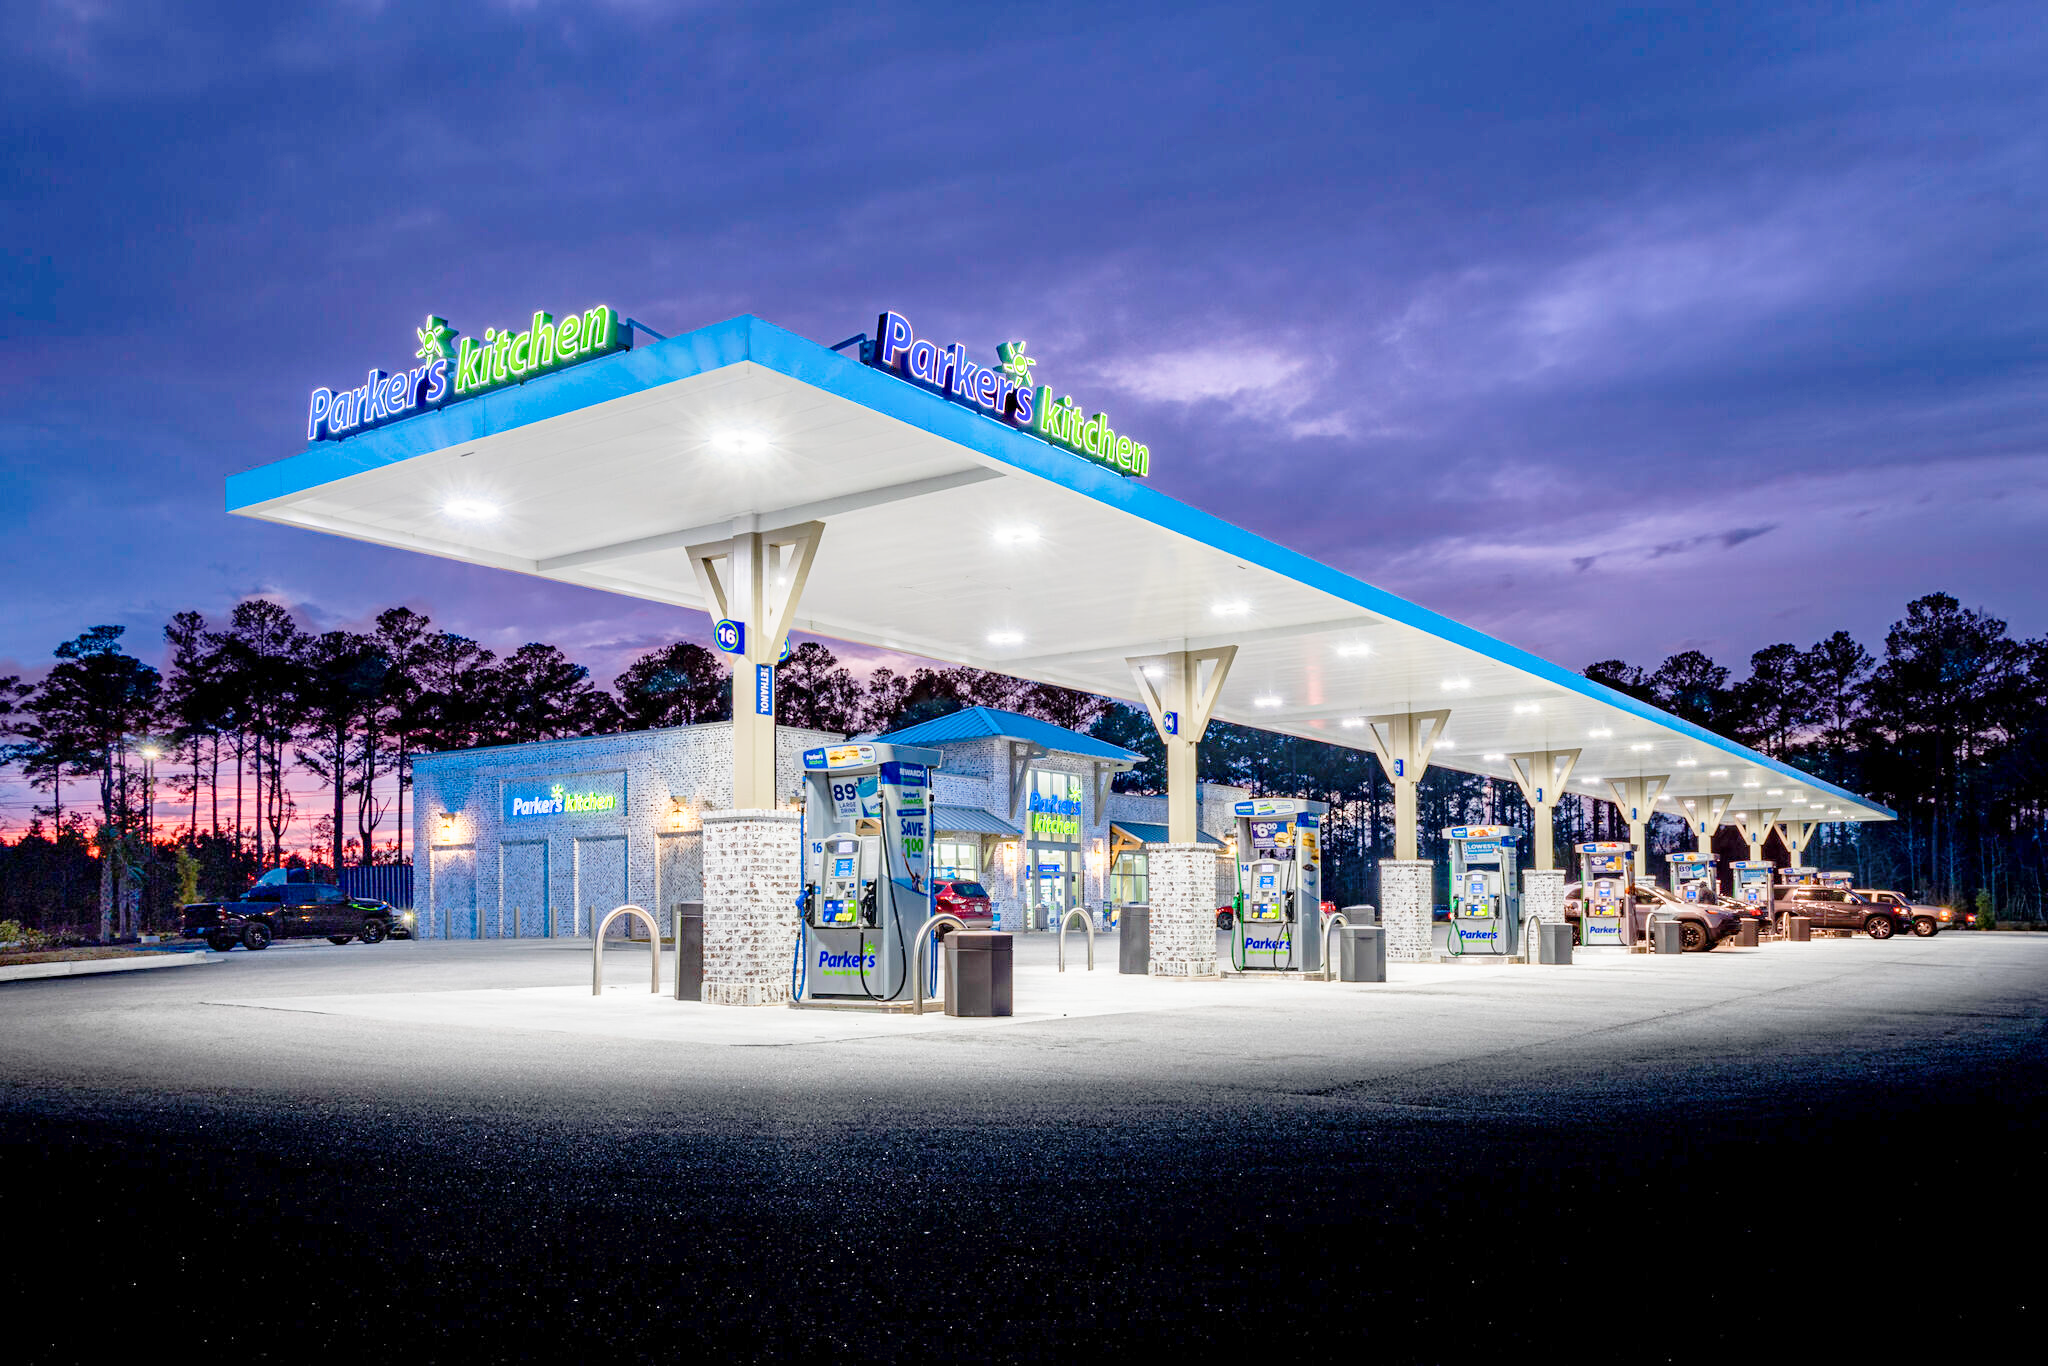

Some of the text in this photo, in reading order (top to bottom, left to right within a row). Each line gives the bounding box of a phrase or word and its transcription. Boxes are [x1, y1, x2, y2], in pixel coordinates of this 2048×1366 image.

[307, 304, 610, 440] Parker's kitchen
[882, 311, 1150, 478] Parker's kitchen
[718, 627, 736, 645] 16
[1164, 716, 1173, 728] 14
[513, 792, 615, 816] Parker's kitchen
[901, 818, 924, 836] SAVE
[1033, 813, 1078, 834] kitchen
[812, 842, 823, 854] 16
[1241, 864, 1250, 872] 14
[818, 950, 876, 968] Parker's
